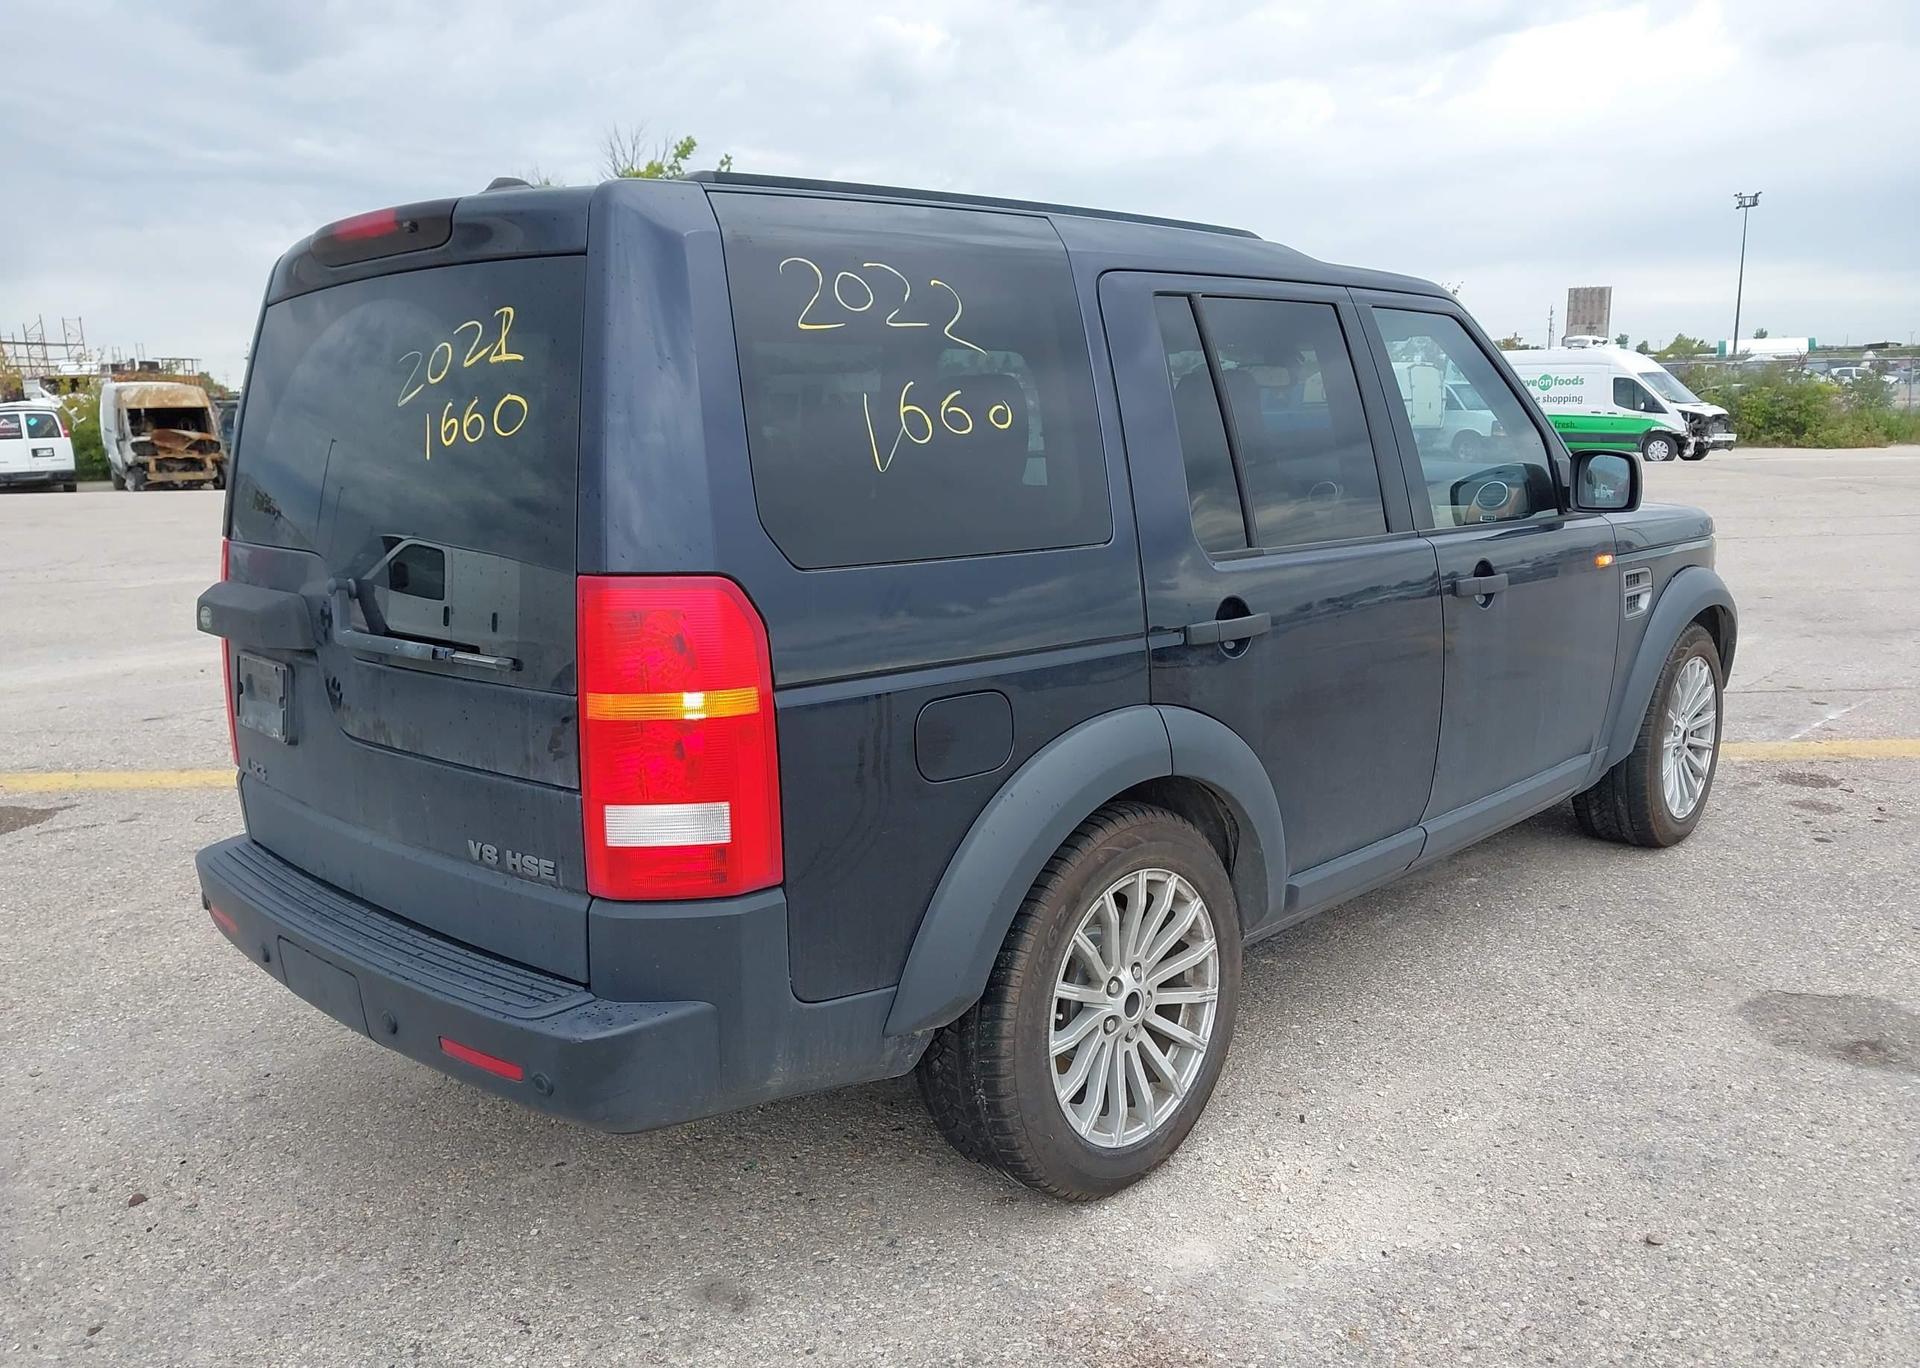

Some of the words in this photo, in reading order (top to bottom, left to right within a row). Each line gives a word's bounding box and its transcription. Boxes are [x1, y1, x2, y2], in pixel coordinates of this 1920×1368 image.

[779, 257, 988, 355] 2022
[1542, 394, 1583, 404] shopping
[1554, 376, 1585, 386] foods
[426, 394, 528, 460] 1660
[467, 839, 499, 865] V8
[505, 850, 557, 881] HSE
